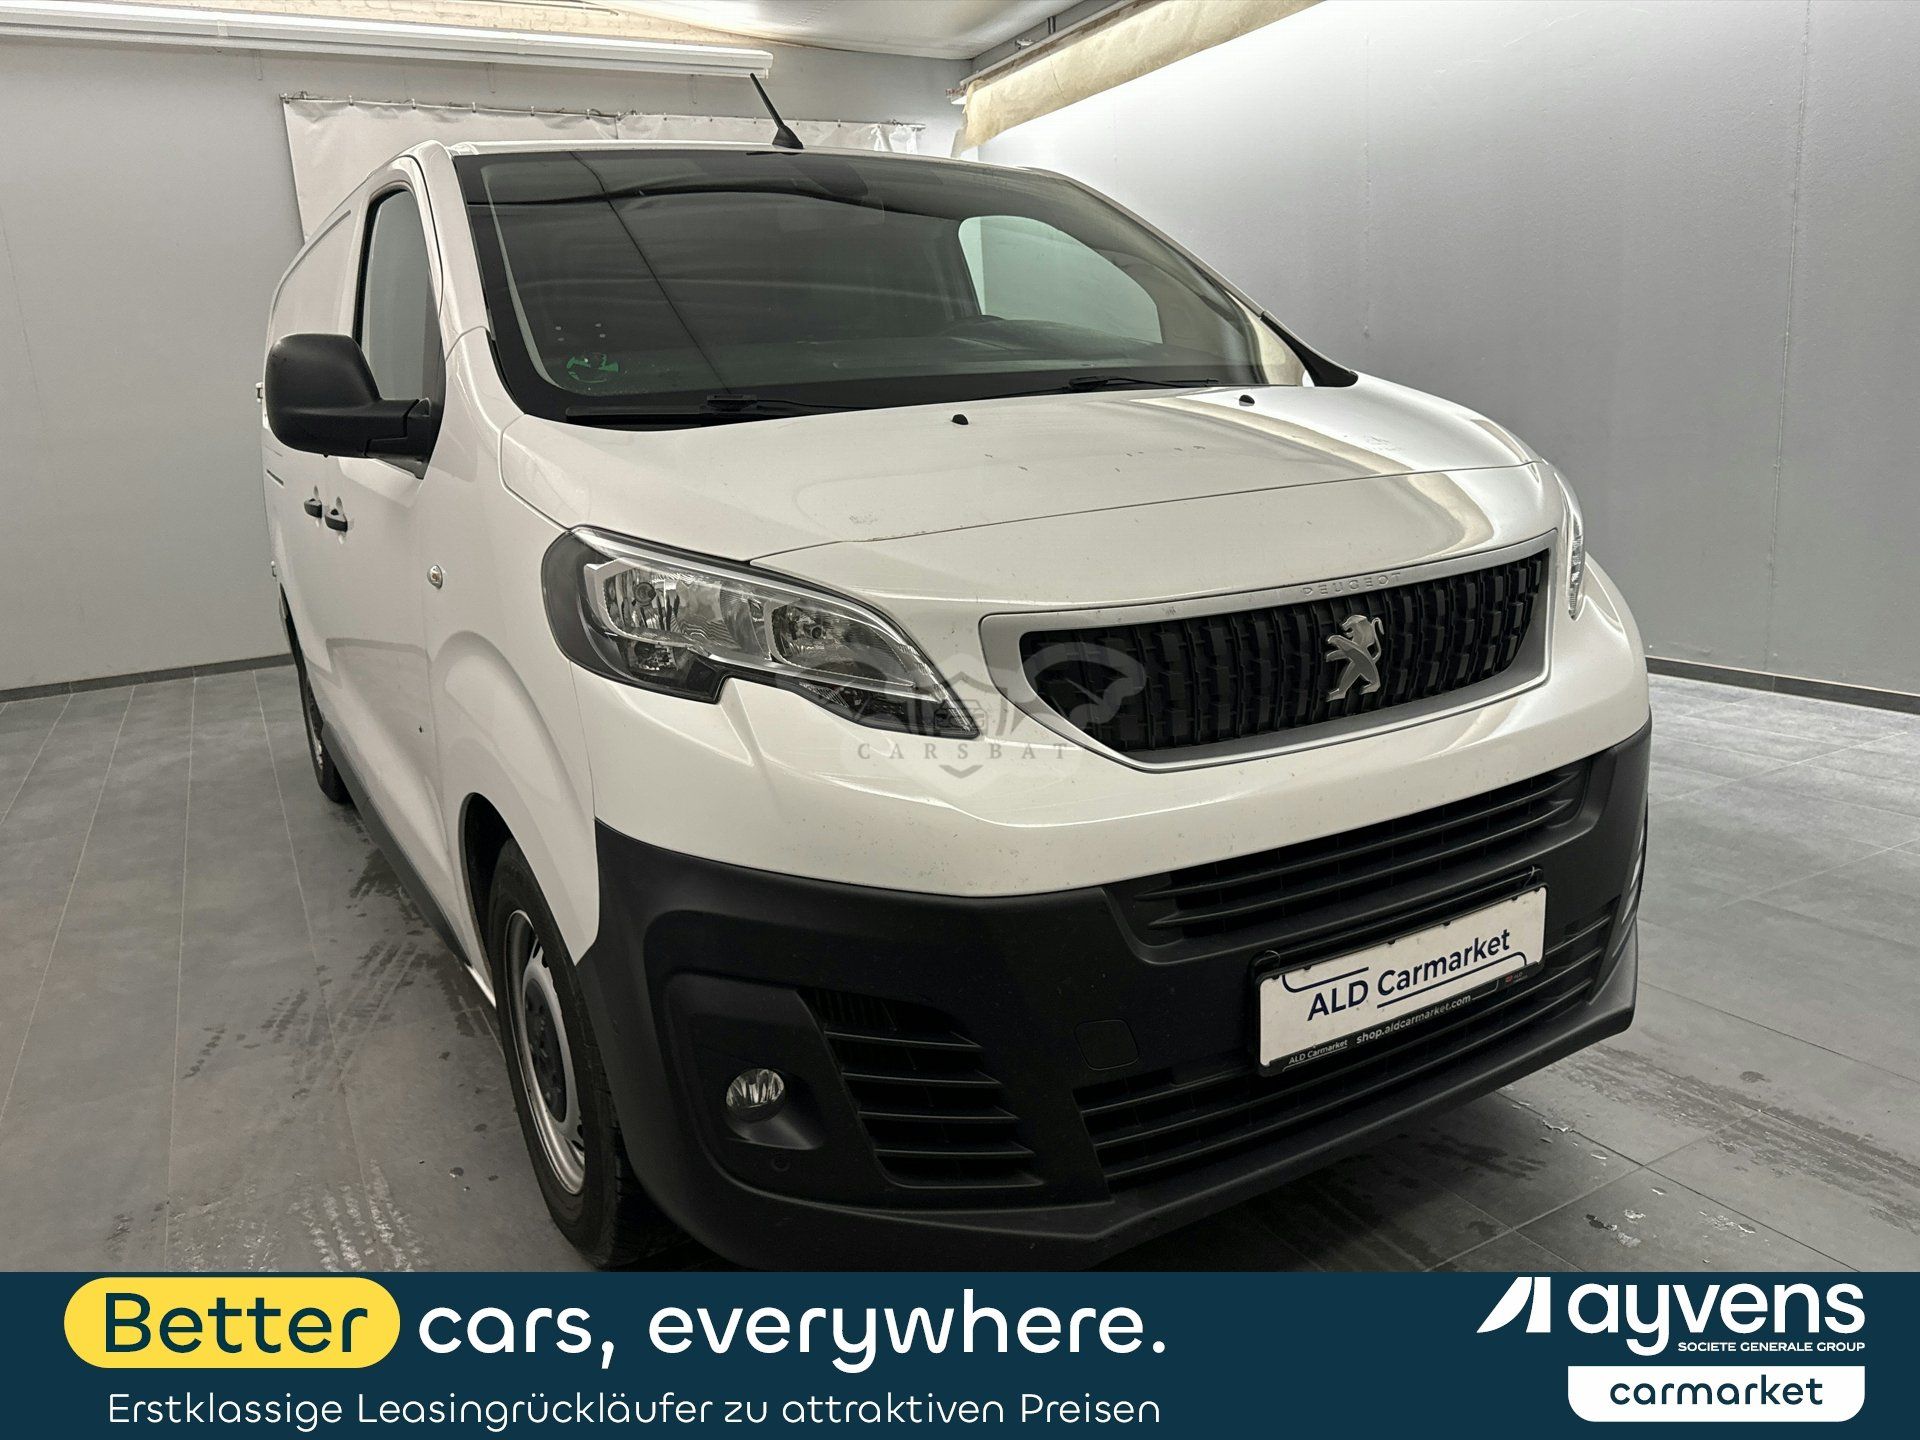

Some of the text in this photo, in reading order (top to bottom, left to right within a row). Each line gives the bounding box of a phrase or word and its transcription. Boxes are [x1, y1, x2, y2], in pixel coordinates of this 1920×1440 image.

[1302, 572, 1401, 596] PEUGEOT
[1307, 928, 1510, 1021] ALD Carmarket
[1356, 994, 1472, 1044] shop.aldcarmarket.com
[1288, 1039, 1348, 1065] ALD Carmarket
